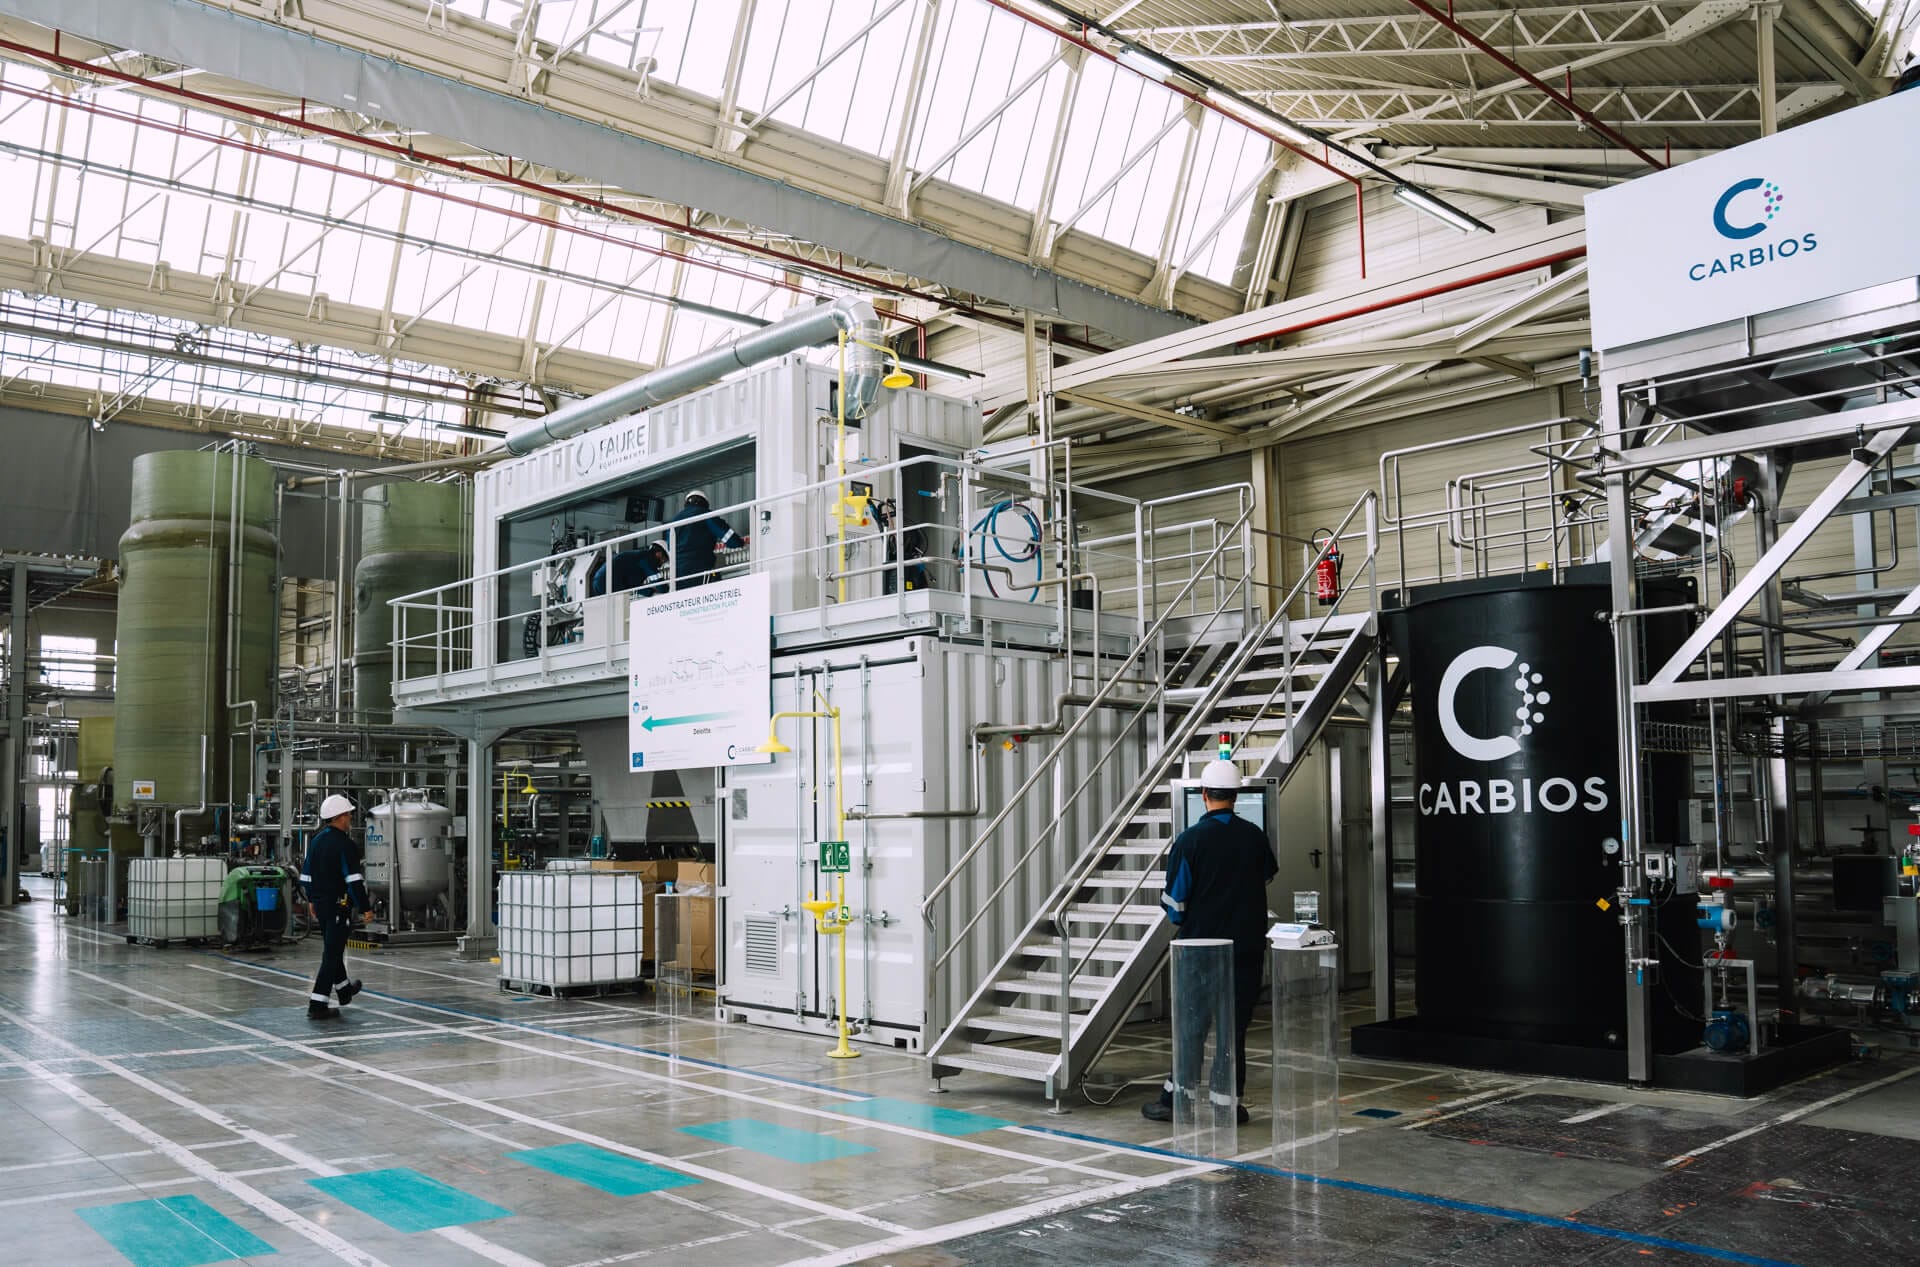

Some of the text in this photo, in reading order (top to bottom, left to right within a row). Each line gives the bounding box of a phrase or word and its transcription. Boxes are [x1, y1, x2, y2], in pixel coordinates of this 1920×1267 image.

[1689, 233, 1817, 281] CARBIOS
[599, 425, 645, 459] FAURE
[646, 587, 742, 616] DÉMONSTRATEUR INDUSTRIEL
[720, 599, 738, 610] PLANT
[1419, 776, 1609, 816] CARBIOS
